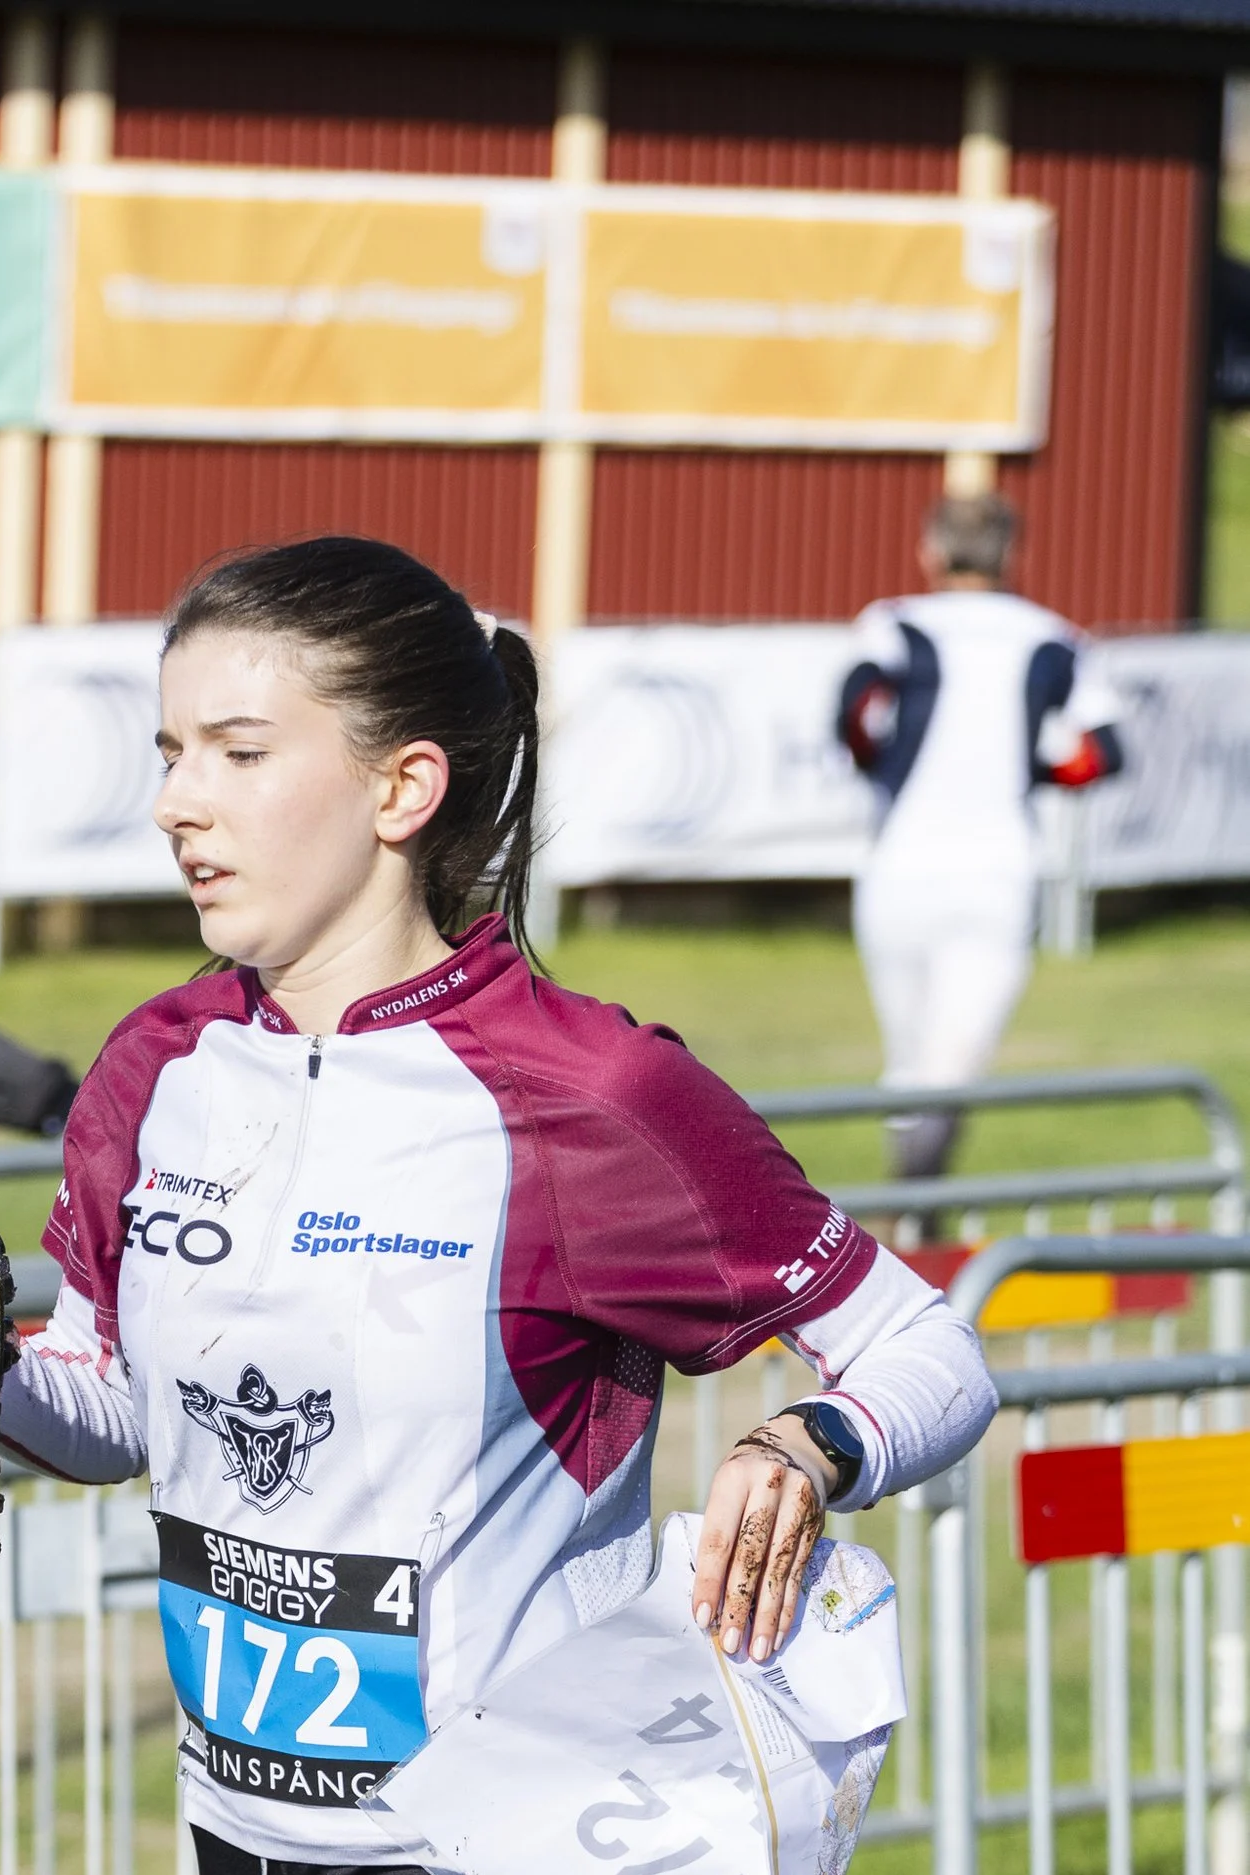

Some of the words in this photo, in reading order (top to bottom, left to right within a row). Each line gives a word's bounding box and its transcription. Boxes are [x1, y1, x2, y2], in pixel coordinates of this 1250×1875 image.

[370, 978, 448, 1021] NYDALENS
[449, 967, 469, 989] SK
[156, 1171, 234, 1206] TRIMTEX
[291, 1232, 474, 1260] Sportslager
[296, 1211, 362, 1231] Oslo
[203, 1531, 337, 1591] SIEMENS
[373, 1564, 415, 1626] 4
[196, 1604, 369, 1748] 172
[204, 1739, 377, 1801] INSPÅNG
